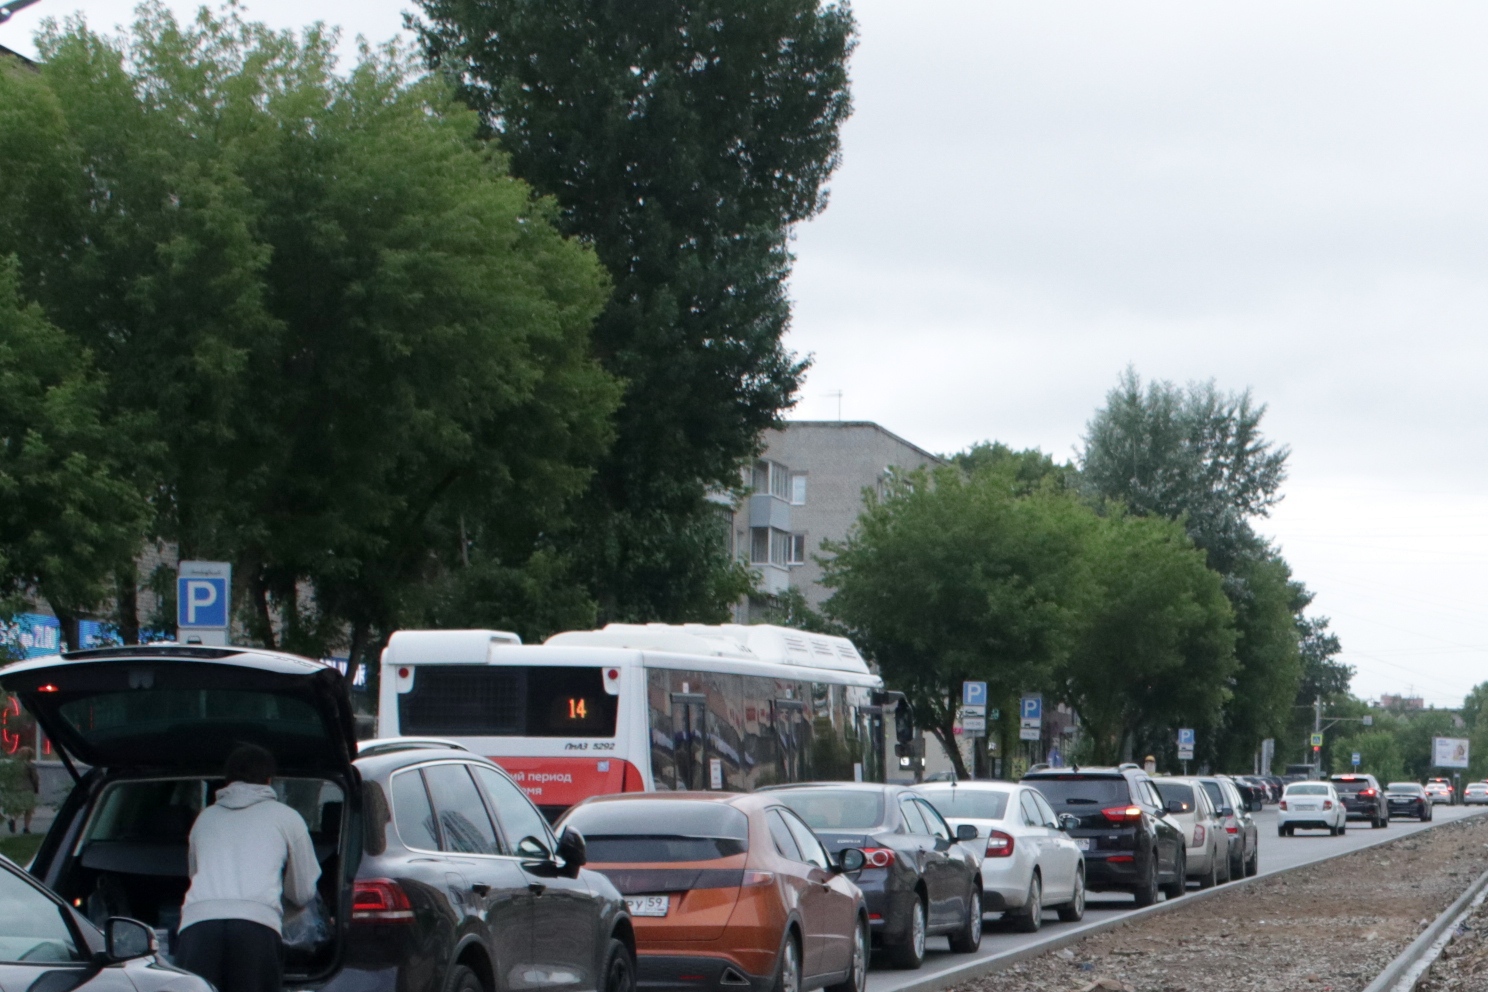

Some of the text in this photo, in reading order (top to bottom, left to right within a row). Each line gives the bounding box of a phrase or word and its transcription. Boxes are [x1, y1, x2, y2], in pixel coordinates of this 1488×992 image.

[187, 581, 217, 624] P
[967, 683, 982, 703] P
[568, 698, 587, 719] 14
[1024, 700, 1037, 718] P
[592, 743, 616, 751] 5292
[527, 773, 573, 784] период
[648, 897, 663, 908] 59
